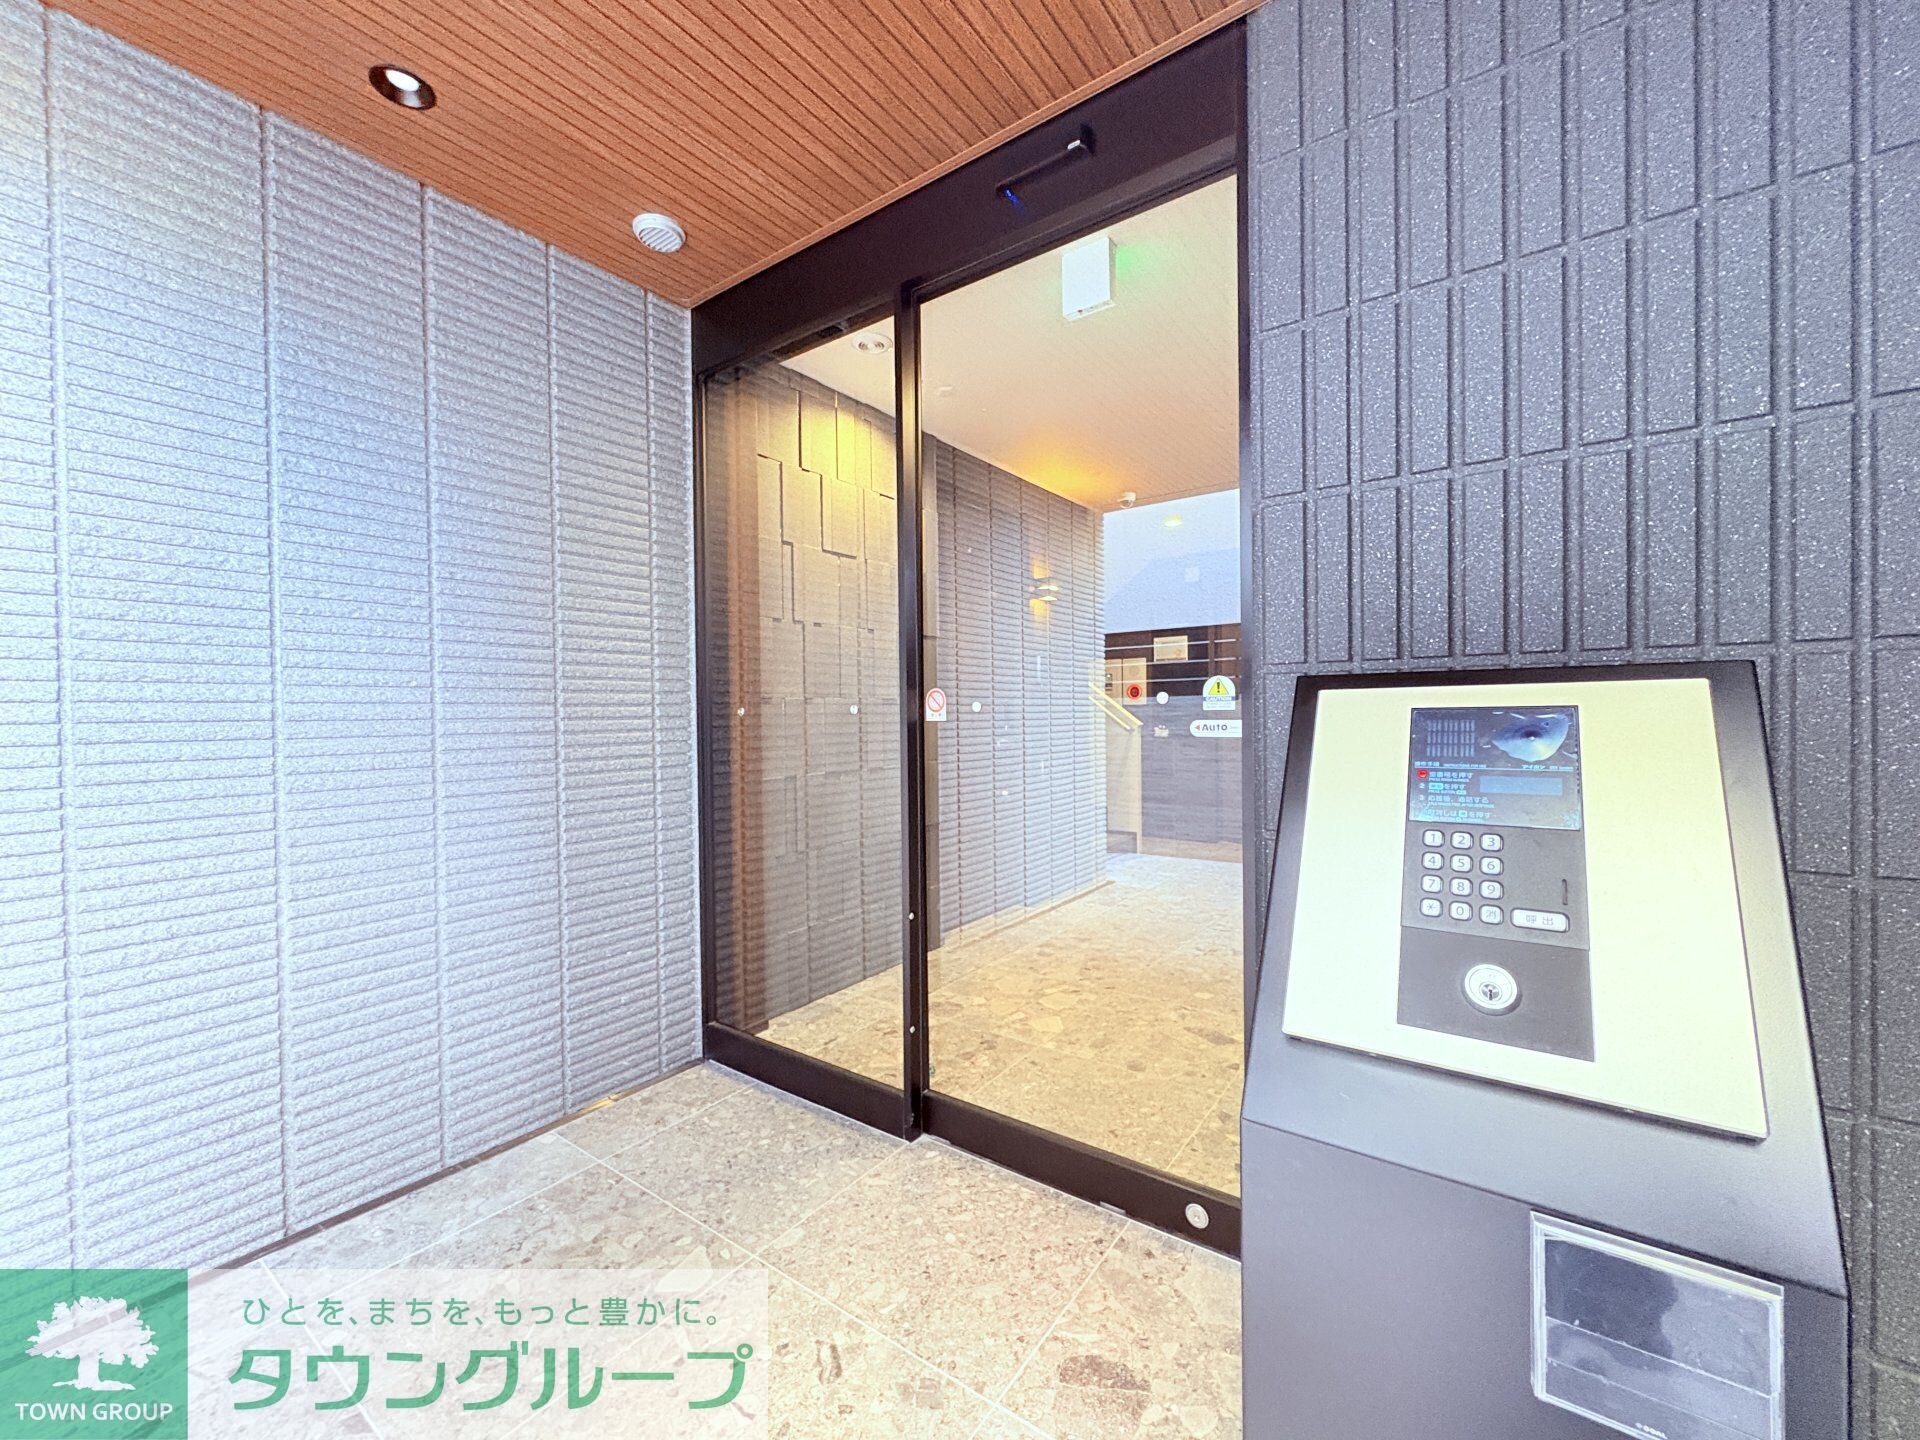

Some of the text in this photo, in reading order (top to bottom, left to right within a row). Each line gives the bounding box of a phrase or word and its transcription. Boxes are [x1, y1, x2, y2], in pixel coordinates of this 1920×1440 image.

[1458, 835, 1466, 845] 2
[1487, 837, 1496, 847] 3
[1428, 856, 1496, 870] 4 5 6
[1428, 879, 1496, 894] 7 8 9
[1456, 906, 1464, 916] 0
